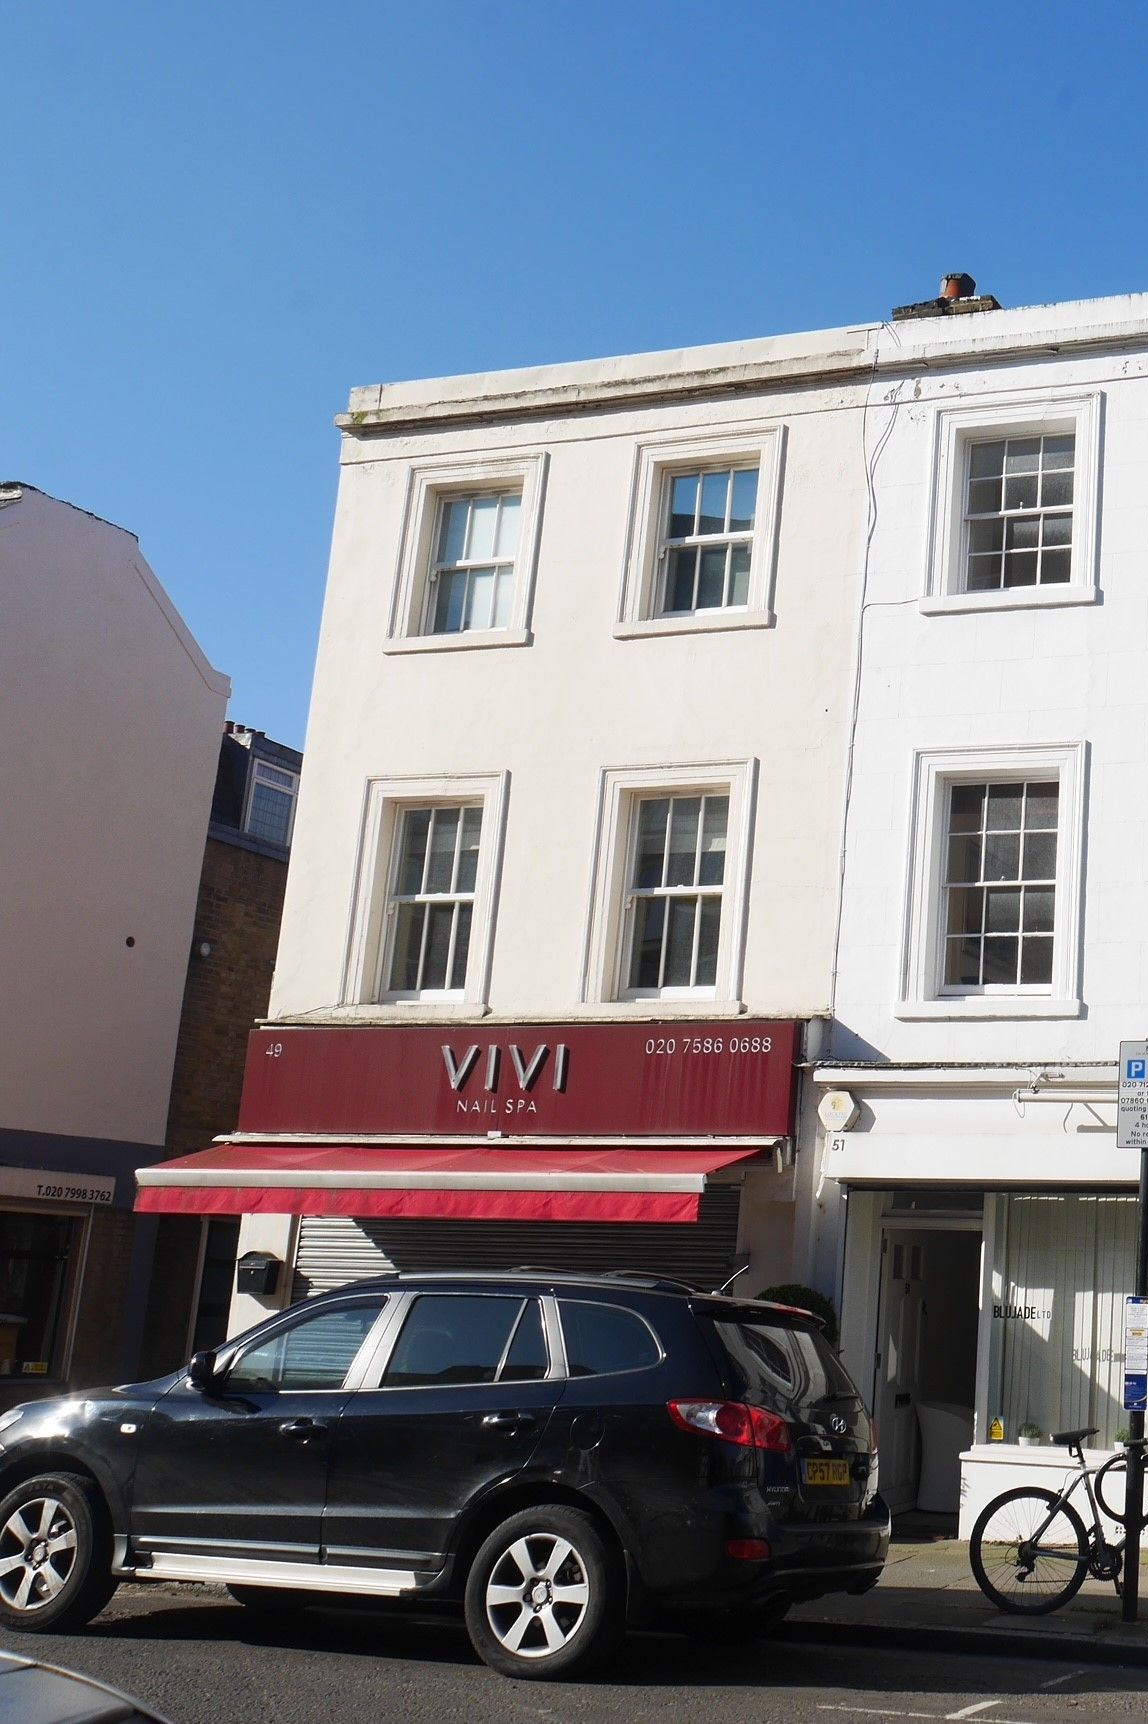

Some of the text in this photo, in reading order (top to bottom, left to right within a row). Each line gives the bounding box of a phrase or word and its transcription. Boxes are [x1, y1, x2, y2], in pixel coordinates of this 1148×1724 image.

[265, 1043, 282, 1057] 49
[645, 1037, 772, 1054] 020 7586 0688
[441, 1043, 566, 1091] VIVI
[1131, 1061, 1143, 1077] P
[456, 1099, 537, 1113] NAIL SPA
[831, 1139, 845, 1152] 51
[64, 1187, 88, 1200] 7998
[89, 1189, 112, 1202] 3762
[993, 1305, 1052, 1319] BLUJADE LTD
